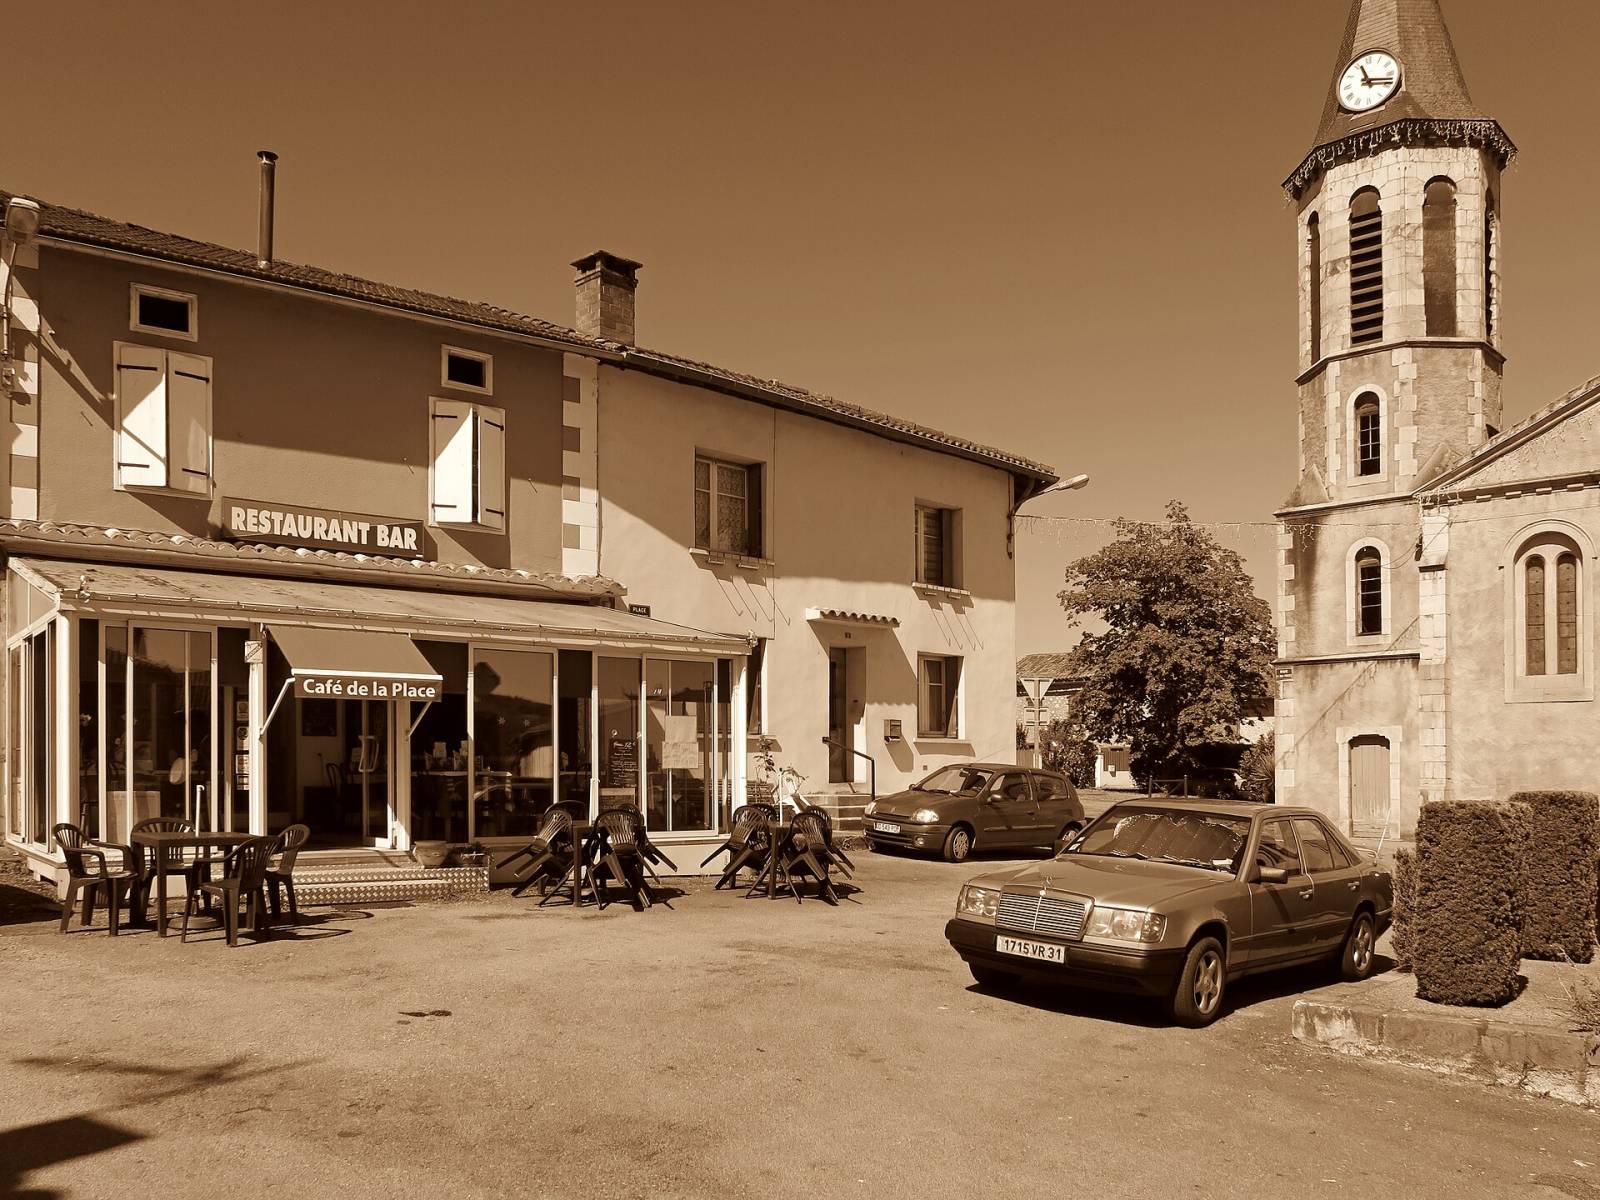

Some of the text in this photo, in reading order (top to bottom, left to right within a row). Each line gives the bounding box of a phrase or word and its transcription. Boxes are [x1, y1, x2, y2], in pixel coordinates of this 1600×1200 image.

[231, 506, 418, 550] RESTAURANT BAR
[303, 679, 436, 698] Café de la Place
